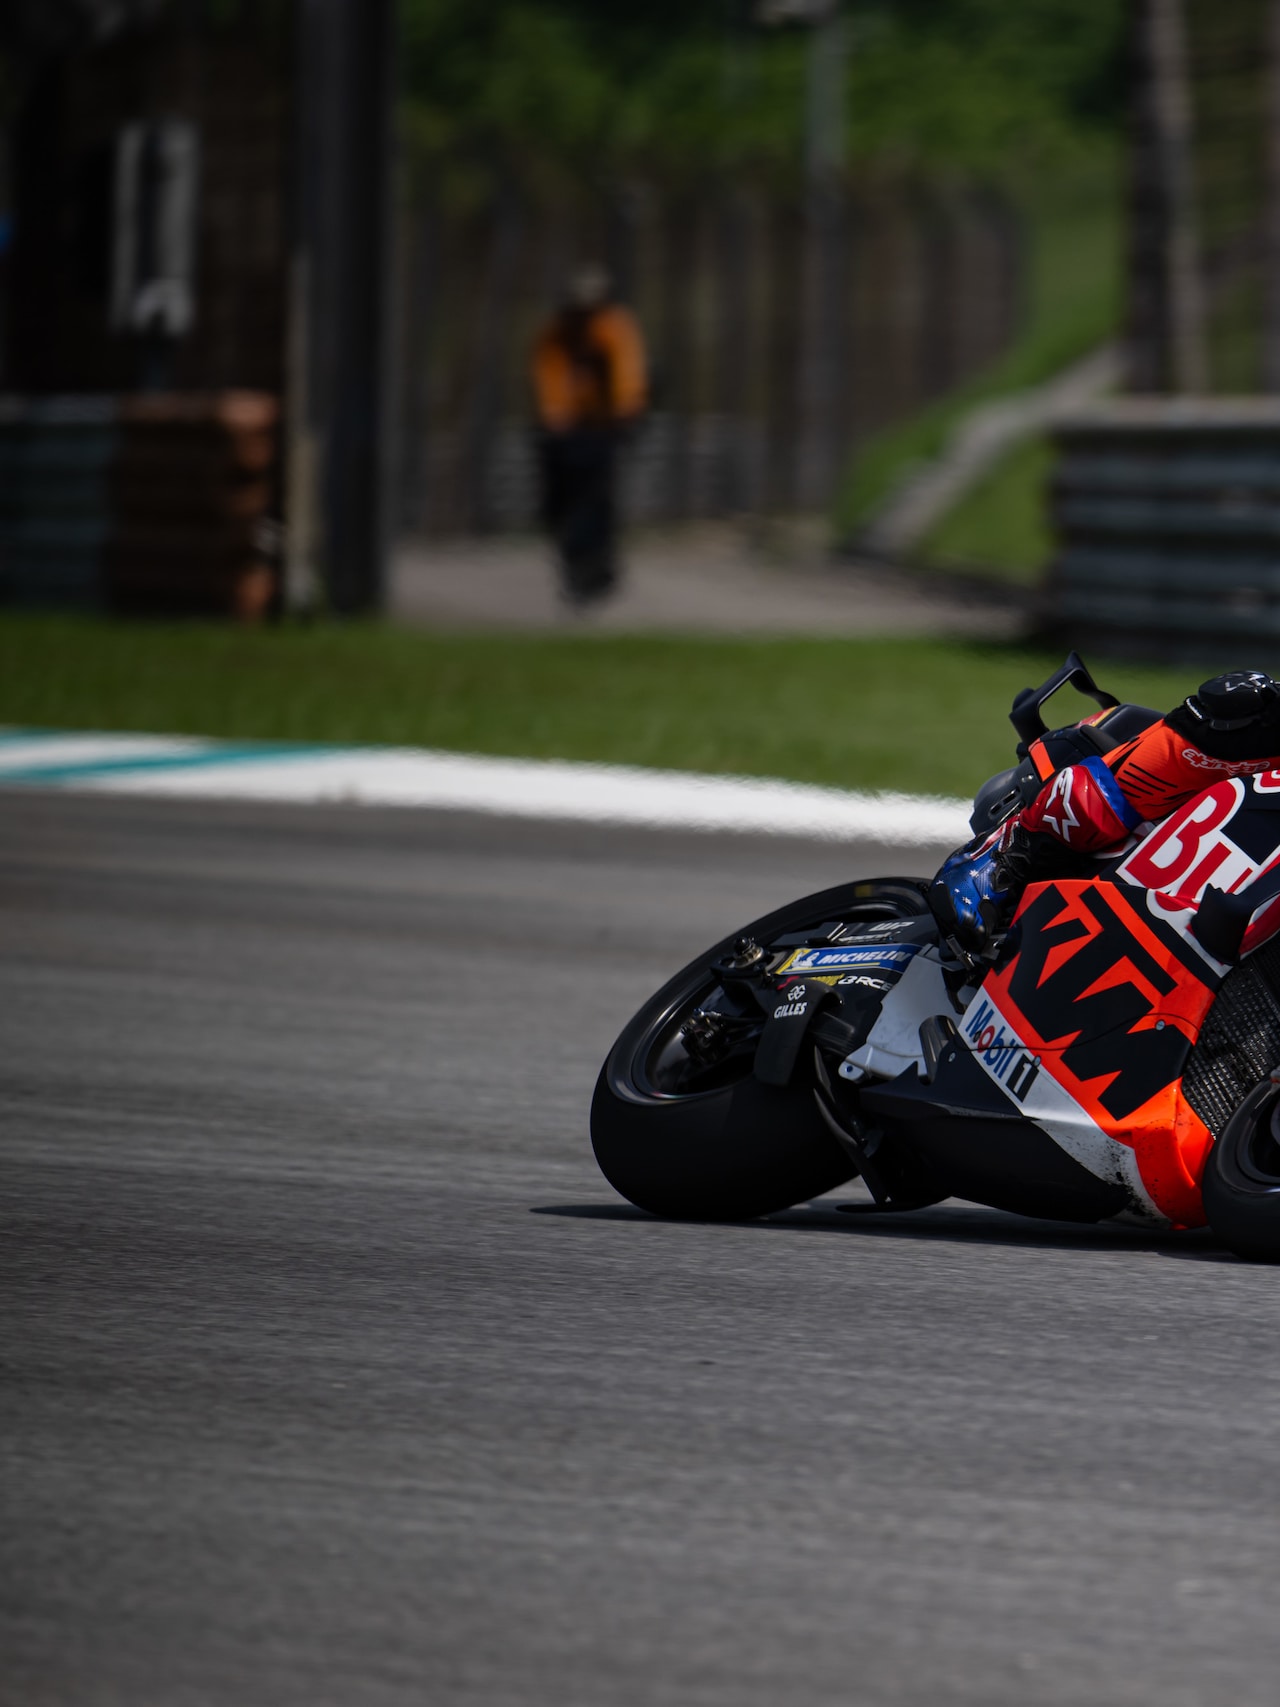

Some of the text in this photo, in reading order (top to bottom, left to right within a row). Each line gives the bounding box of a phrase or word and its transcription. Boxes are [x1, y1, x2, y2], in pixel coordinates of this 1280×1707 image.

[816, 950, 912, 965] MICHELIN
[774, 1002, 807, 1019] GILLES
[1007, 883, 1191, 1121] KTM
[965, 999, 1040, 1103] Mobil 1
